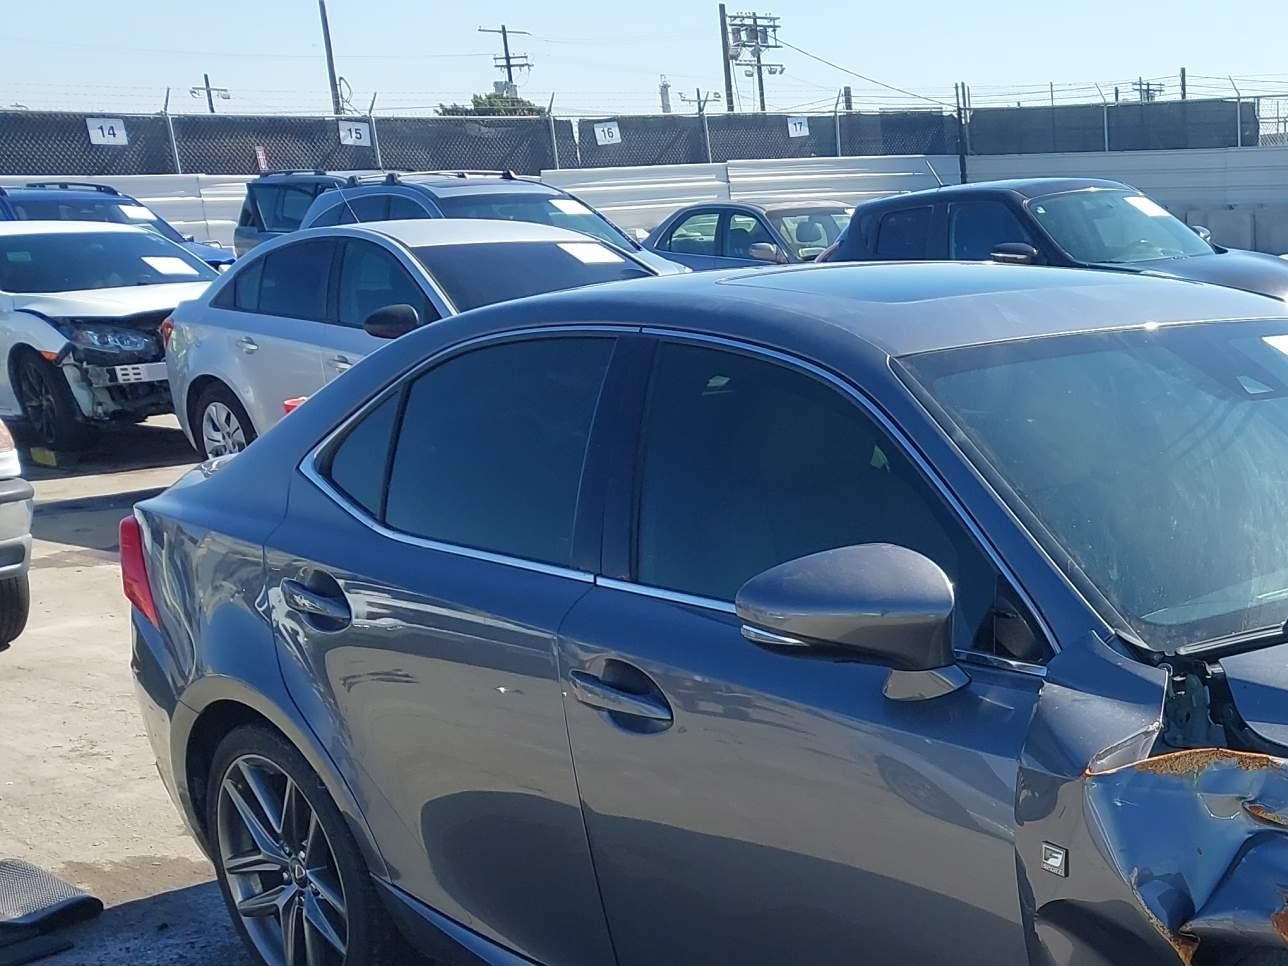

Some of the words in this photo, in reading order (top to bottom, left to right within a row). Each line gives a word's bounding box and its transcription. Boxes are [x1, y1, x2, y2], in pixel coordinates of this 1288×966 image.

[97, 124, 117, 139] 14
[793, 121, 803, 132] 17
[347, 127, 362, 140] 15
[600, 127, 614, 140] 16
